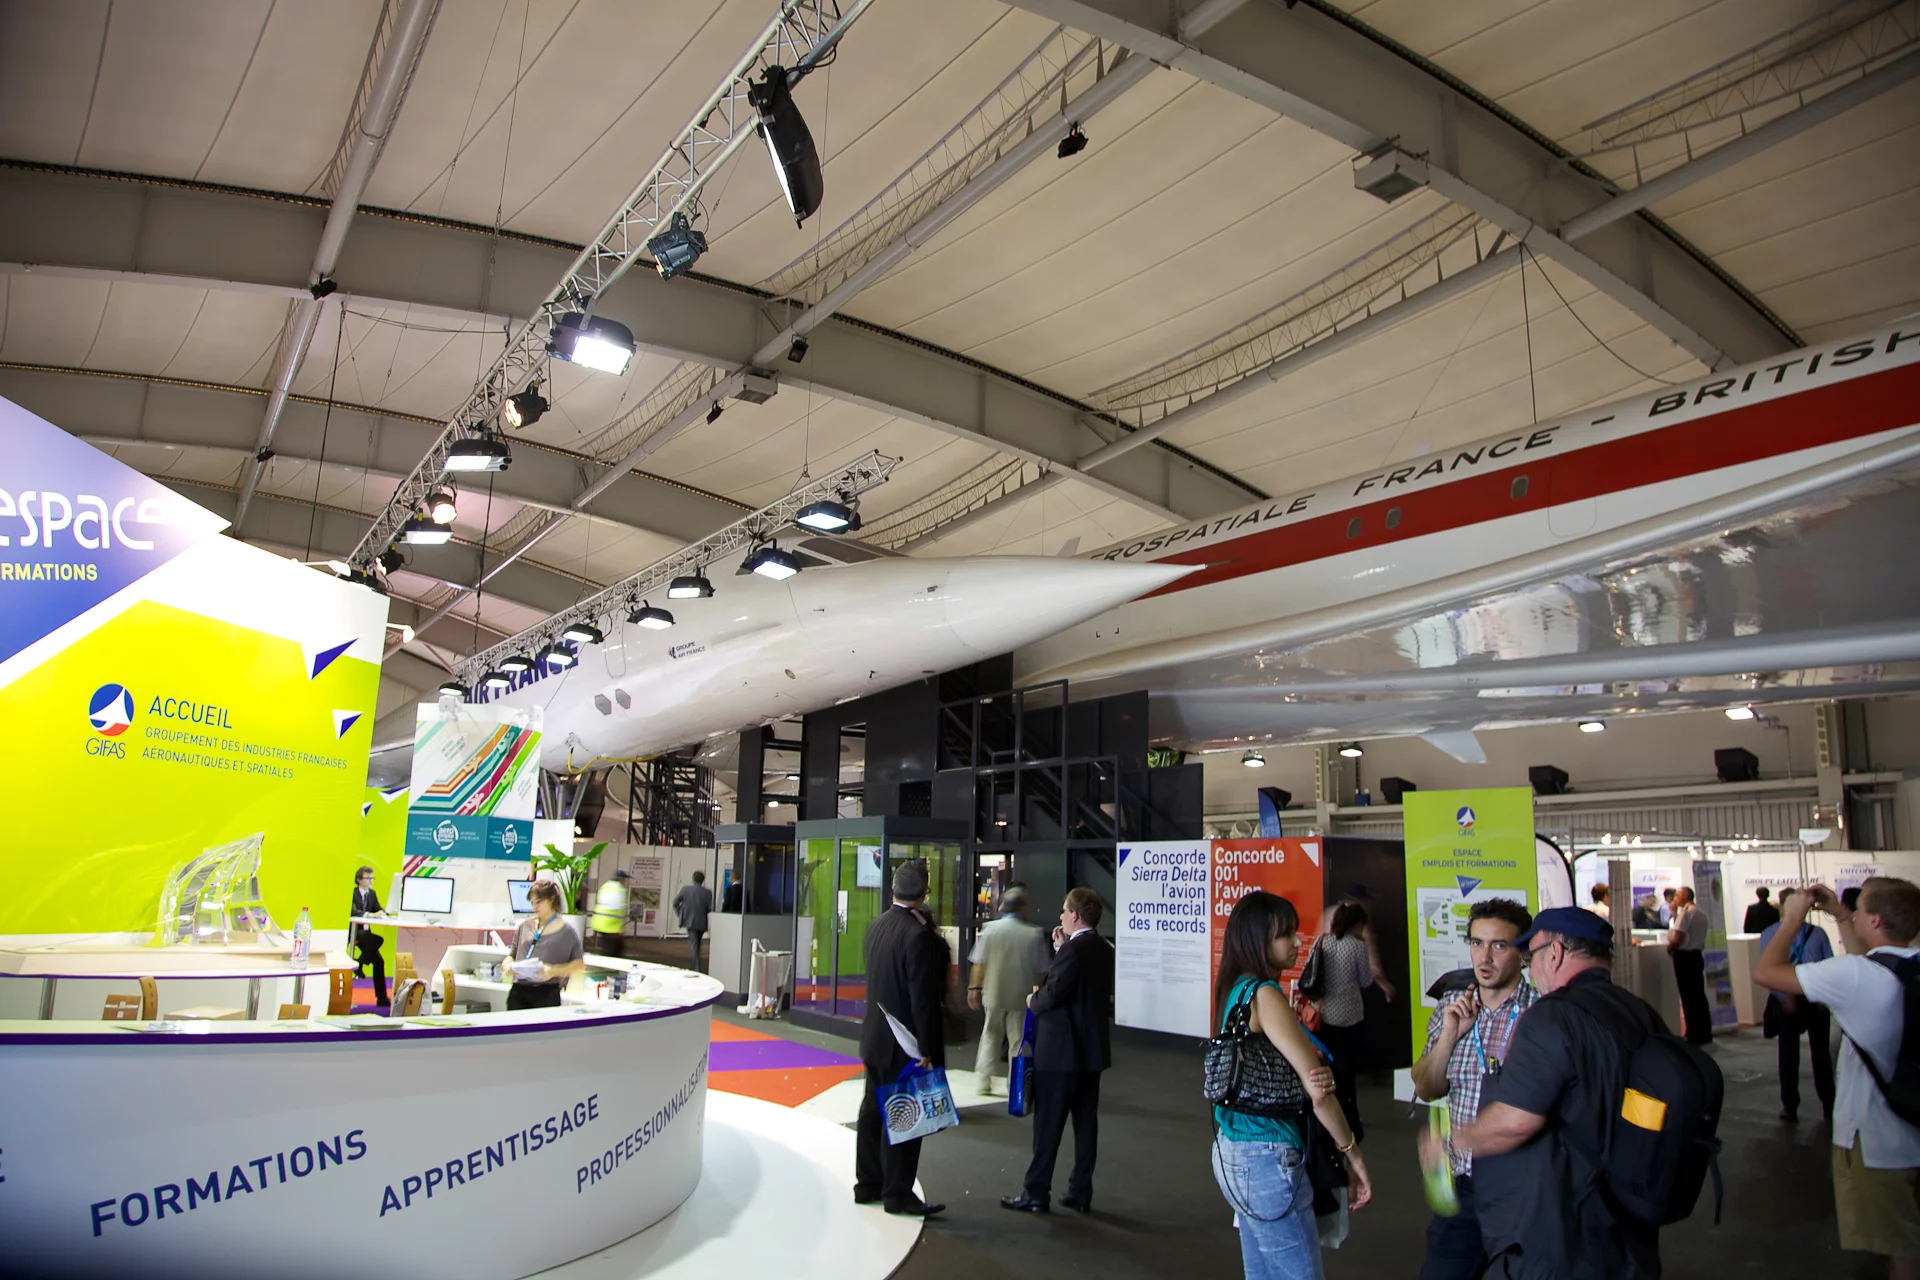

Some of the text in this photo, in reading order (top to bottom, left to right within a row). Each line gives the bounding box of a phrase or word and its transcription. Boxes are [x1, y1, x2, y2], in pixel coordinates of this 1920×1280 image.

[1353, 425, 1560, 496] FRANCE
[1648, 331, 1920, 417] BRITISH
[676, 641, 696, 652] GROUPE
[686, 645, 706, 657] FRANCE
[149, 695, 232, 729] ACCUEIL
[86, 737, 126, 760] GIFAS
[145, 727, 218, 748] GROUPEMENT
[221, 739, 240, 752] DES
[243, 743, 296, 761] INDUSTRIES
[142, 746, 293, 779] AÉRONAUTIQUES ET SPATIALES
[1143, 849, 1206, 865] Concorde
[1214, 846, 1285, 864] Concorde
[1453, 849, 1482, 857] ESPACE
[1422, 860, 1516, 868] EMPLOIS ET FORMATIONS
[1132, 866, 1207, 882] Sierra Delta
[1214, 865, 1239, 882] 001
[1162, 883, 1206, 899] l'avion
[1128, 900, 1206, 916] commercial
[1129, 916, 1206, 934] des records
[379, 1093, 600, 1217] APPRENTISSAGE
[90, 1129, 367, 1237] FORMATIONS
